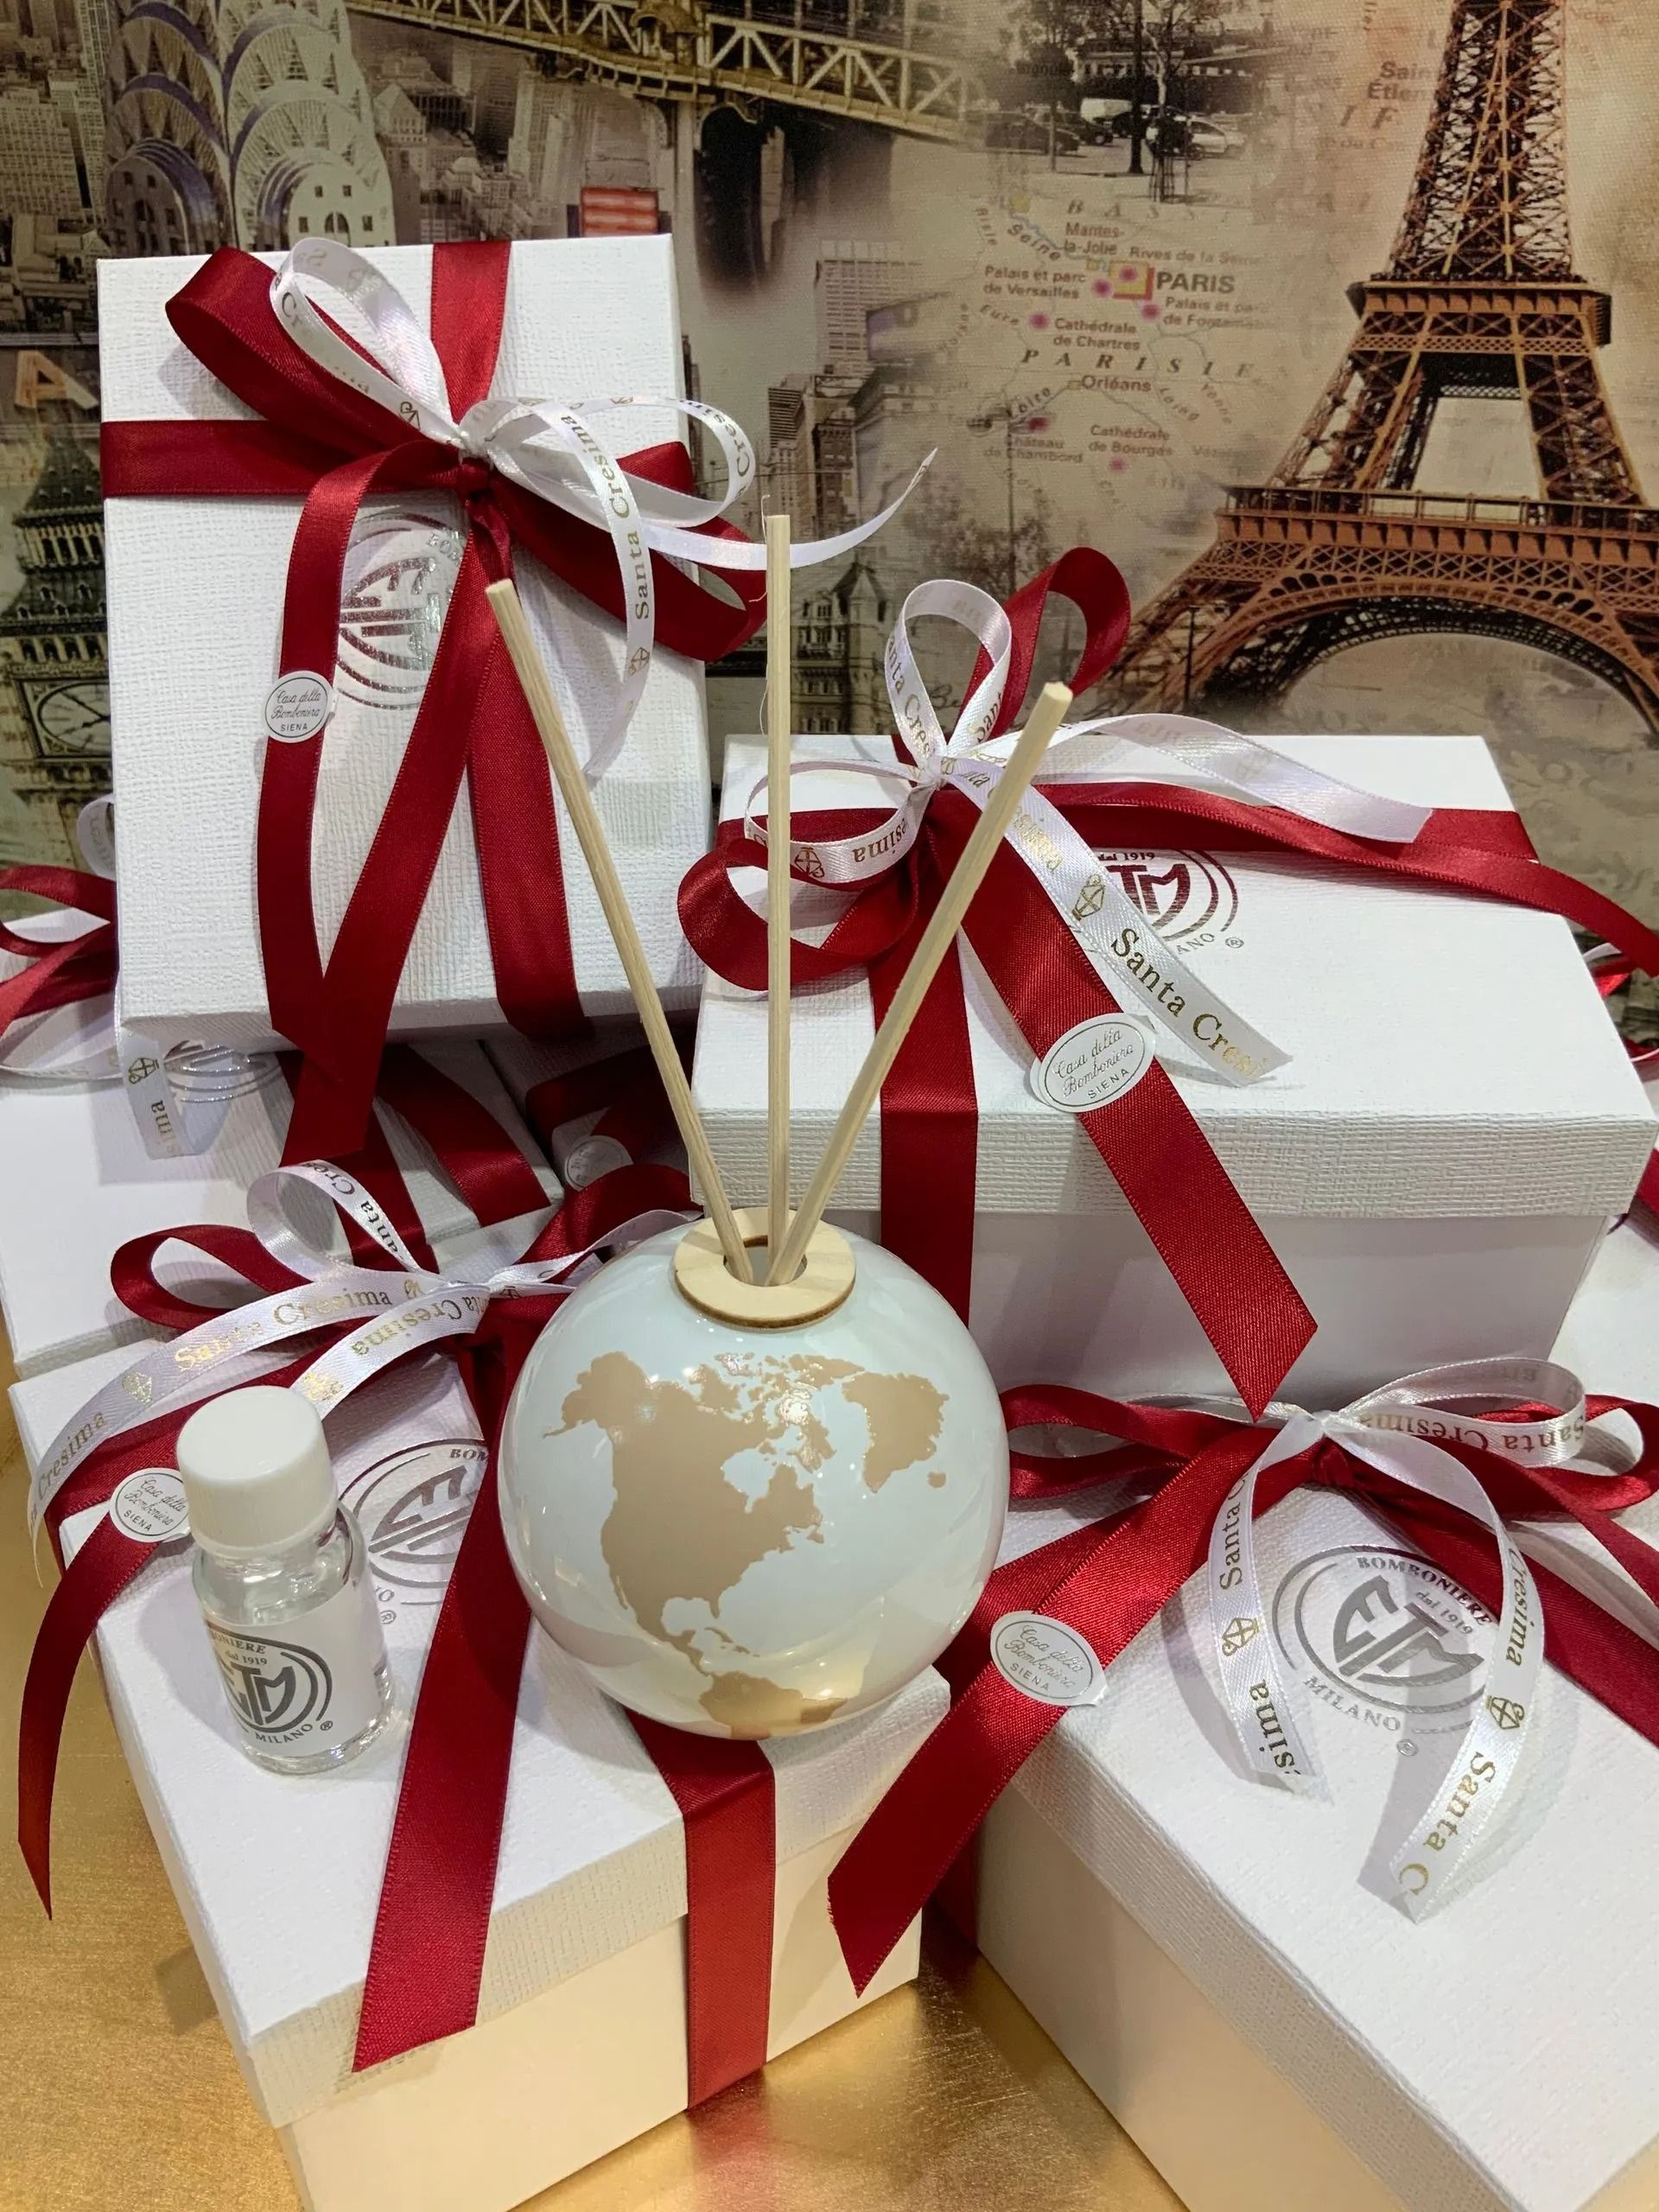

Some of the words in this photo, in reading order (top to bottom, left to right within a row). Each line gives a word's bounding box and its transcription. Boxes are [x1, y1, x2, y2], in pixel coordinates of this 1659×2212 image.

[1007, 224, 1060, 261] Seine
[983, 283, 1002, 295] de
[1007, 283, 1080, 299] Versailles
[985, 265, 1030, 280] Palais
[1033, 270, 1048, 281] et
[1052, 272, 1086, 284] parc
[1156, 271, 1236, 294] PARIS
[1054, 335, 1071, 346] de
[1077, 335, 1140, 350] Chartres
[1082, 374, 1152, 392] Orléans
[561, 415, 630, 518] Cresima
[627, 530, 650, 620] Santa
[280, 723, 308, 732] SIENA
[1123, 851, 1155, 861] 1919
[1110, 927, 1186, 1018] Santa
[1087, 1068, 1129, 1099] SIENA
[351, 1299, 462, 1356] Cresima
[1502, 1415, 1585, 1453] Santa
[37, 1411, 106, 1502] Cresima
[124, 1510, 152, 1531] SIENA
[1219, 1503, 1243, 1591] Santa
[1356, 1556, 1493, 1626] BOMBONIERE
[1415, 1591, 1442, 1610] dal
[1441, 1606, 1474, 1635] 1919
[242, 1656, 268, 1666] 1919
[1010, 1662, 1052, 1692] SIENA
[1303, 1675, 1402, 1731] MILANO
[255, 1723, 313, 1744] MILANO
[1422, 1750, 1497, 1852] Santa
